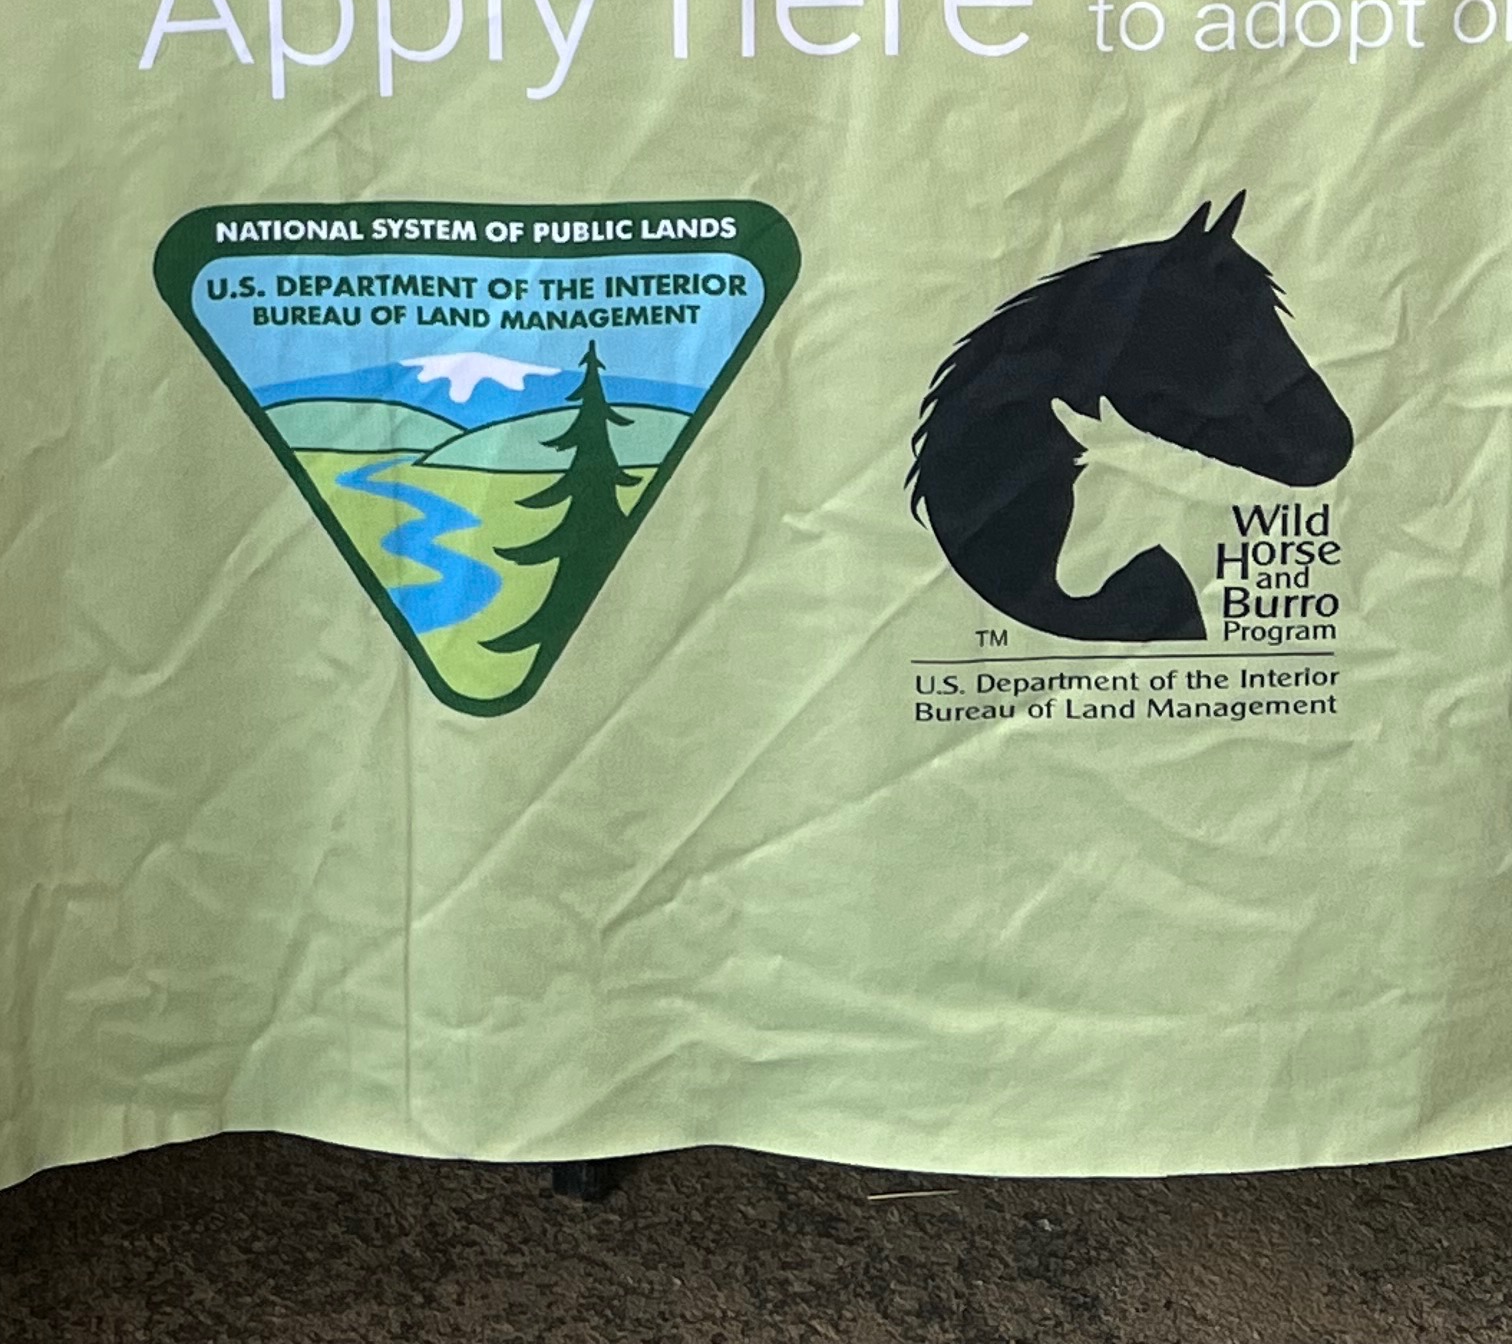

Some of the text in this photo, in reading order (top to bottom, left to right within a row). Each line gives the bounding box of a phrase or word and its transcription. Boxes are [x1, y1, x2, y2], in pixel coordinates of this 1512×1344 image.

[215, 217, 737, 244] NATIONAL SYSTEM OF PUBLIC LANDS
[206, 273, 748, 302] U.S. DEPARTMENT OF THE INTERIOR
[251, 304, 701, 333] BUREAU OF LAND MANAGEMENT
[1231, 502, 1330, 538] Wild
[1215, 539, 1342, 580] Horse
[1255, 566, 1309, 589] and
[1222, 586, 1340, 619] Burro
[975, 629, 1009, 648] TM
[1223, 621, 1337, 646] Program
[915, 666, 1341, 697] U.S. Department of the Interior
[914, 694, 1338, 723] Bureau of Land Management
